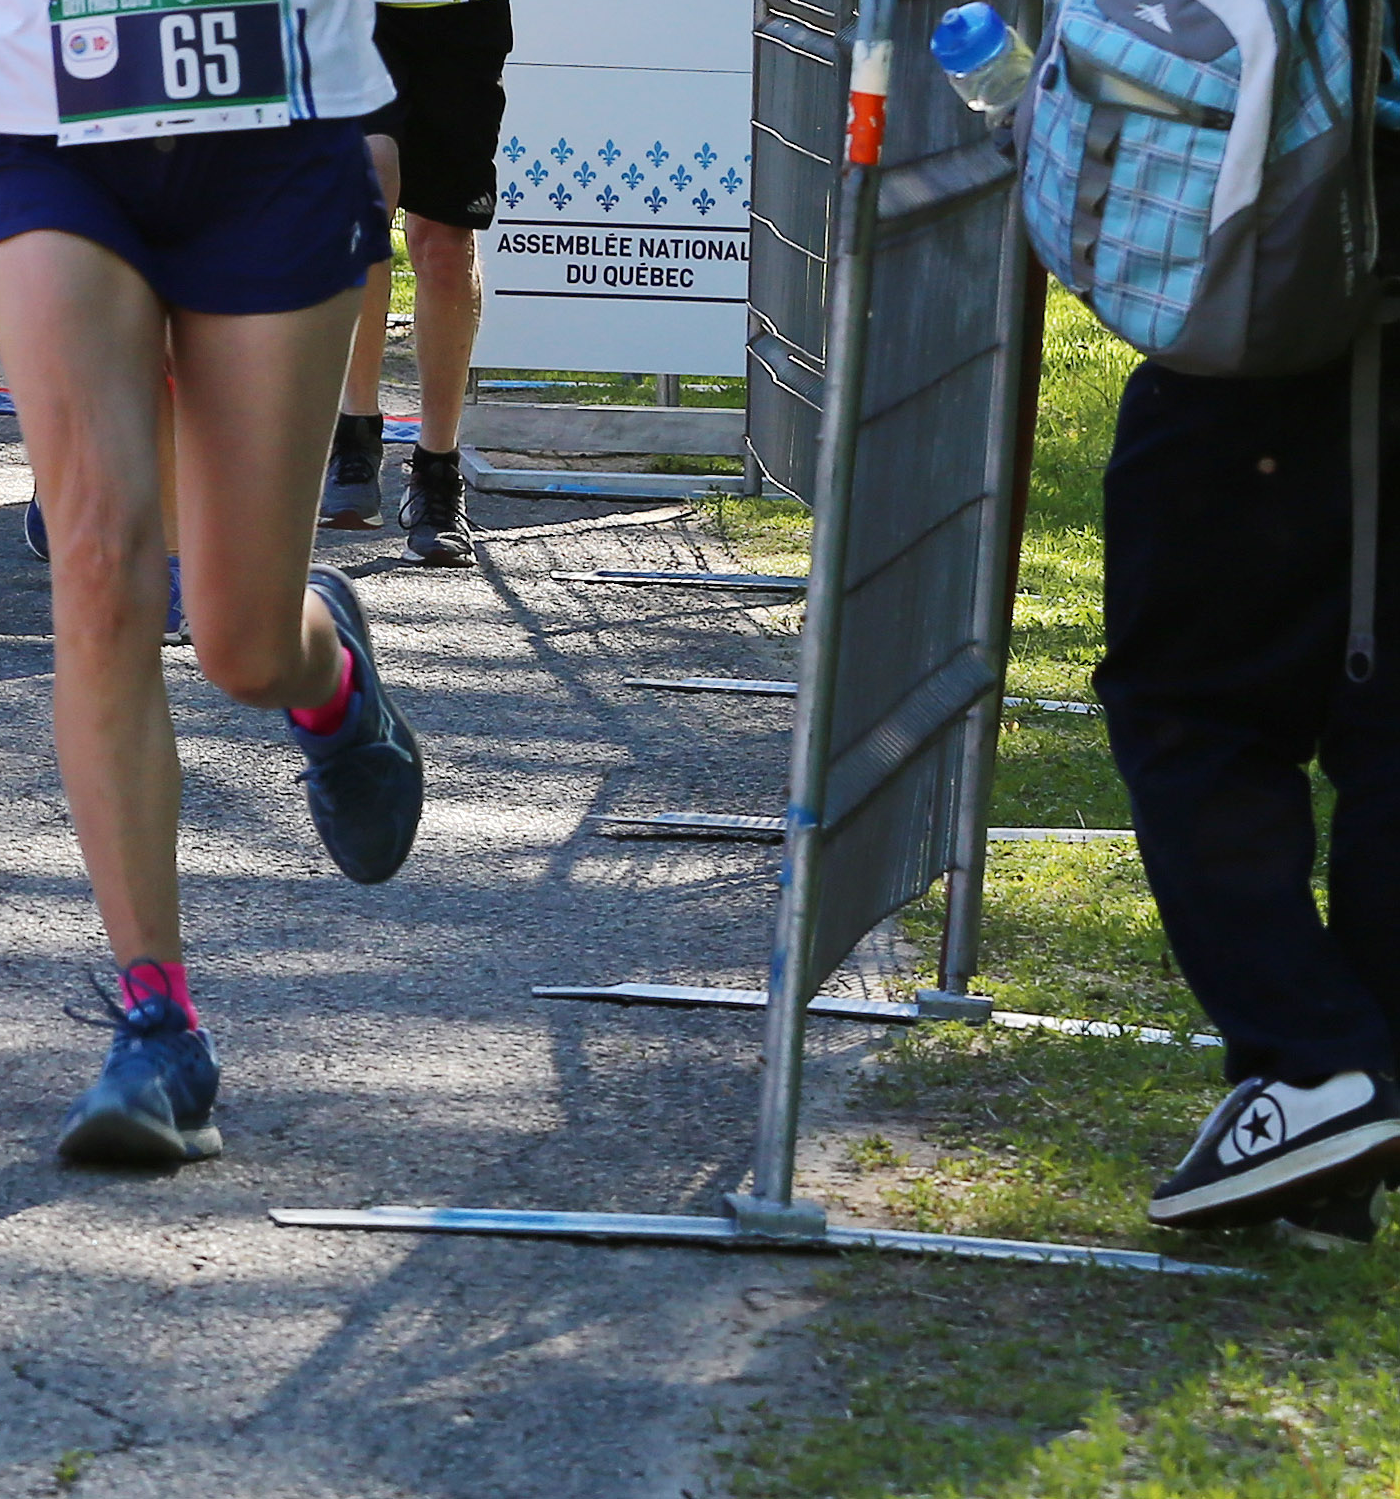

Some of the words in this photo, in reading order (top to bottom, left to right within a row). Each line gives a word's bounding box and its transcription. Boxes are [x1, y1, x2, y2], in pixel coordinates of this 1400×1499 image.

[159, 11, 241, 100] 65
[497, 233, 632, 257] ASSEMBLÉE
[639, 238, 750, 261] NATIONAL
[566, 264, 597, 284] DU
[603, 263, 694, 288] QUÉBEC
